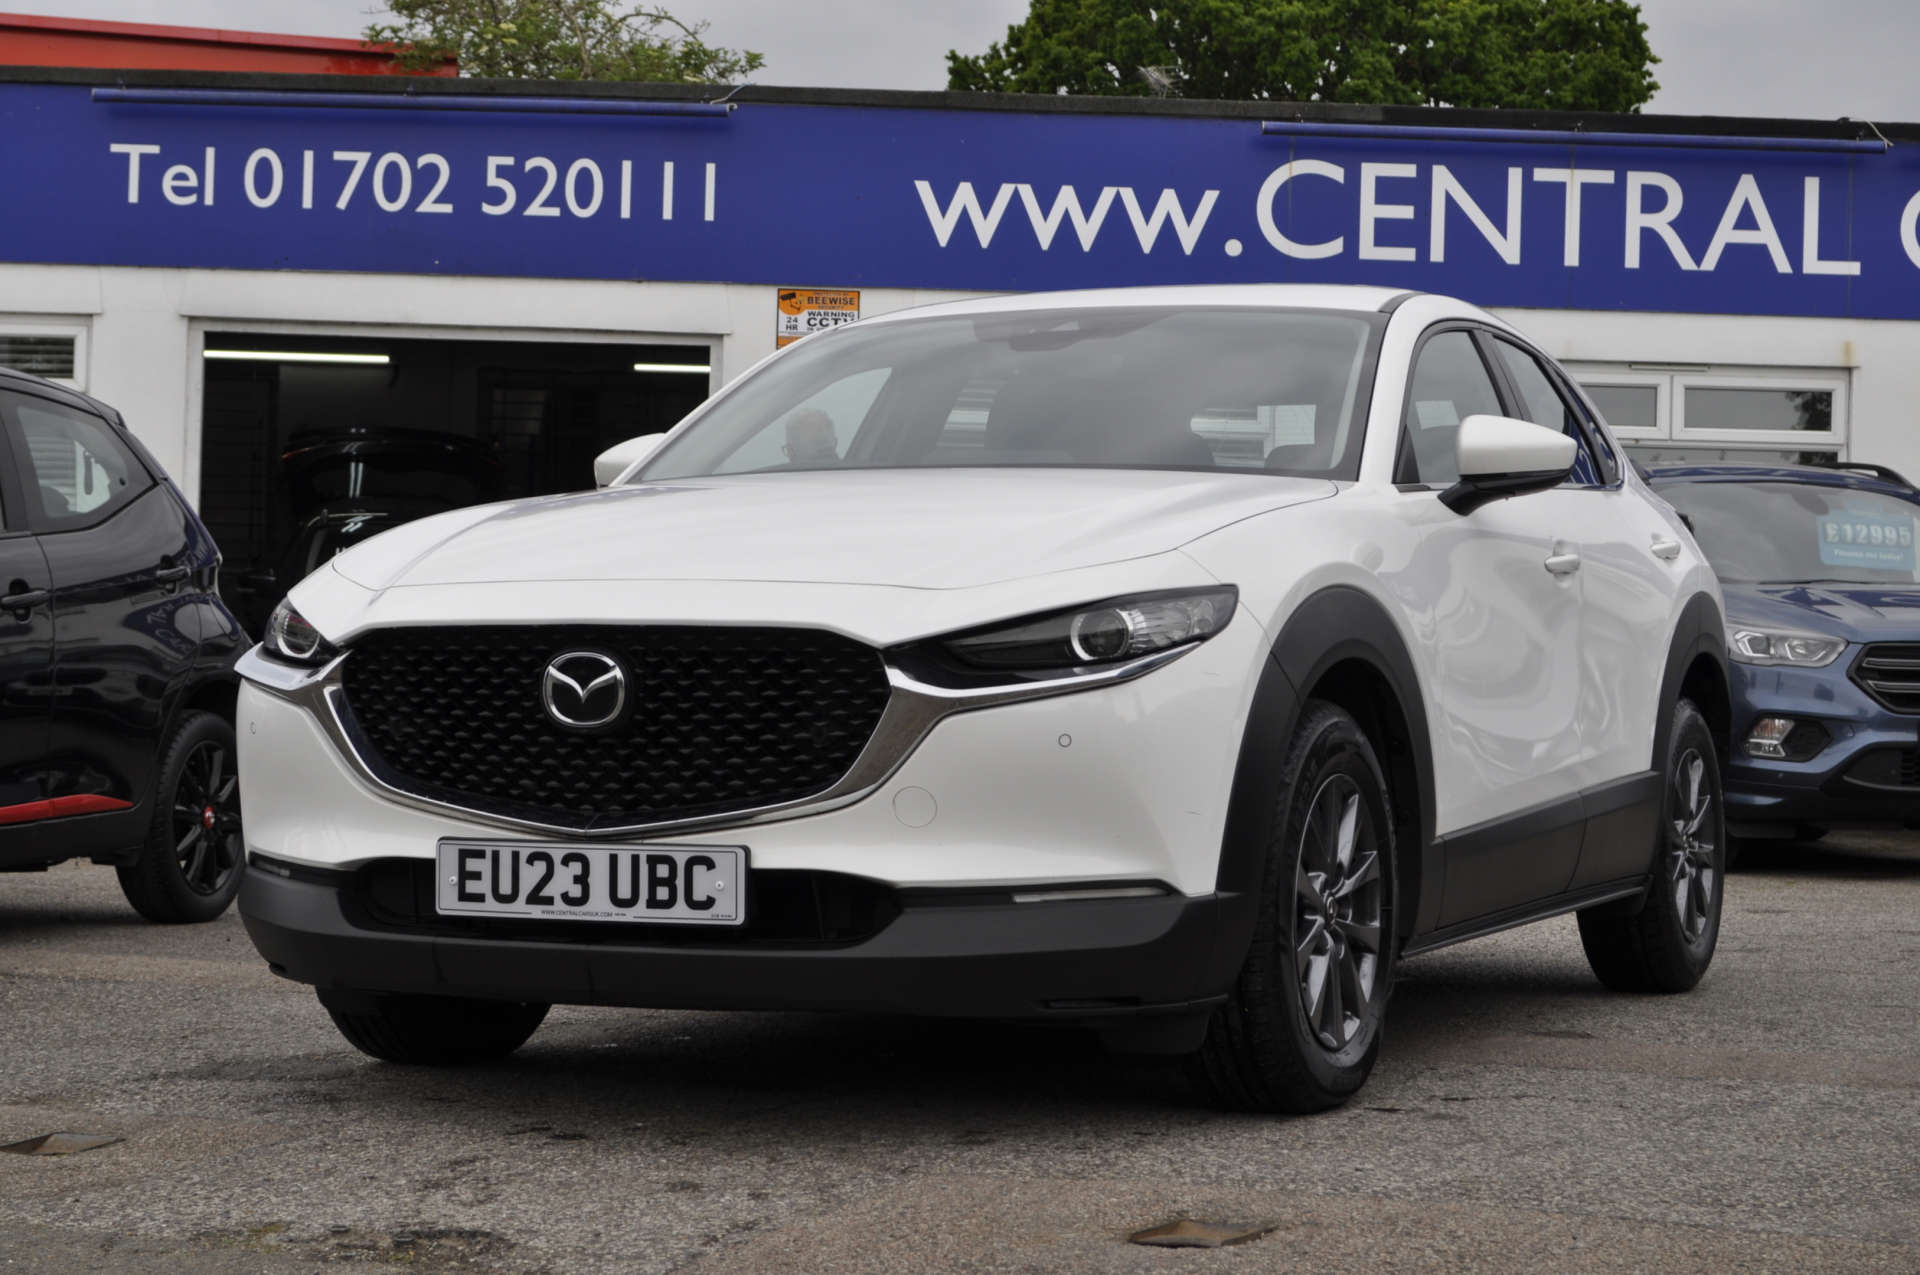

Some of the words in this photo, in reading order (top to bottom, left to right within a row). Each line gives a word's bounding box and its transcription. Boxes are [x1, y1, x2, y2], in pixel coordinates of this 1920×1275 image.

[109, 143, 216, 206] Tel
[244, 147, 454, 214] 01702
[481, 156, 716, 222] 520111
[807, 296, 857, 306] BEEWISE
[1824, 522, 1912, 547] £12995
[457, 848, 591, 907] EU23
[608, 853, 717, 911] UBC
